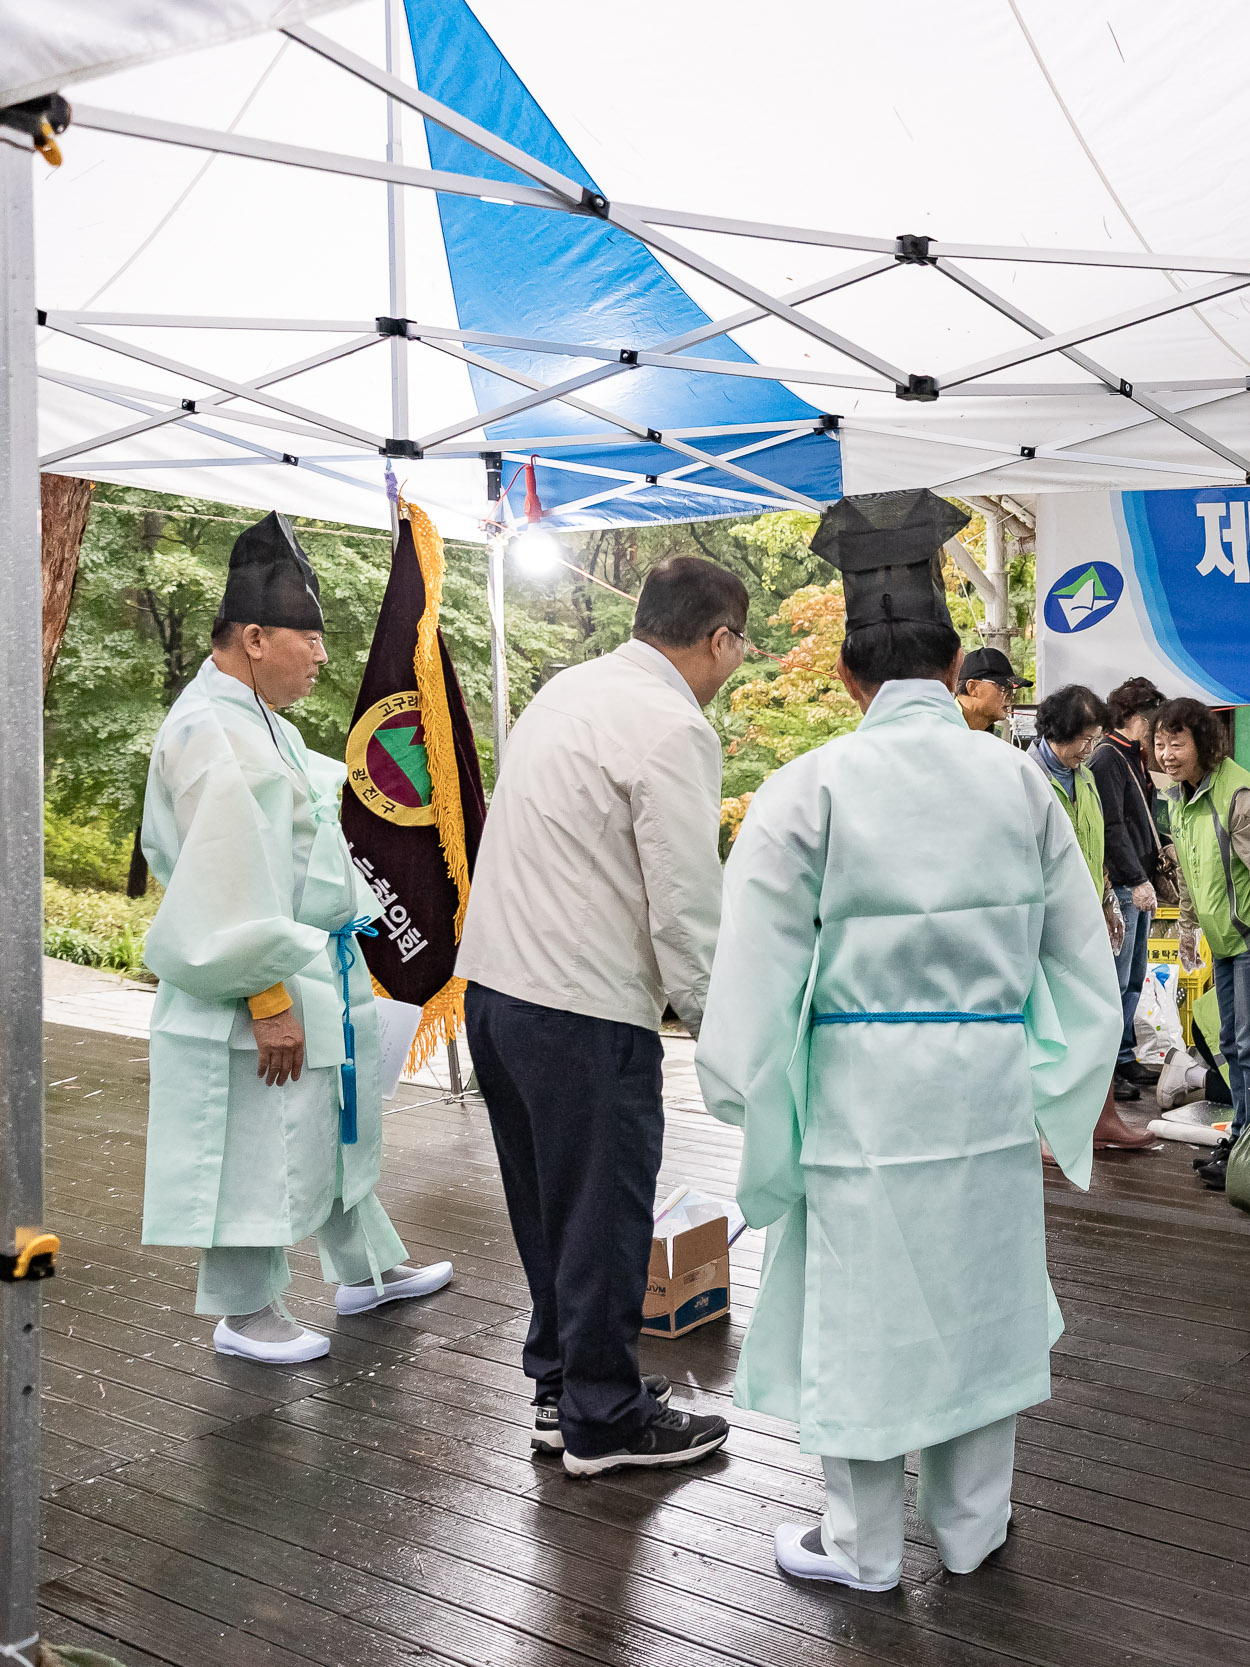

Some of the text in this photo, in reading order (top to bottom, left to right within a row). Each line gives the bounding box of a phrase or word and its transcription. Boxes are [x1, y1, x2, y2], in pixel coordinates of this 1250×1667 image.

[352, 768, 397, 814] 광진구
[348, 841, 429, 963] 협의회
[1147, 949, 1180, 960] 울탁주
